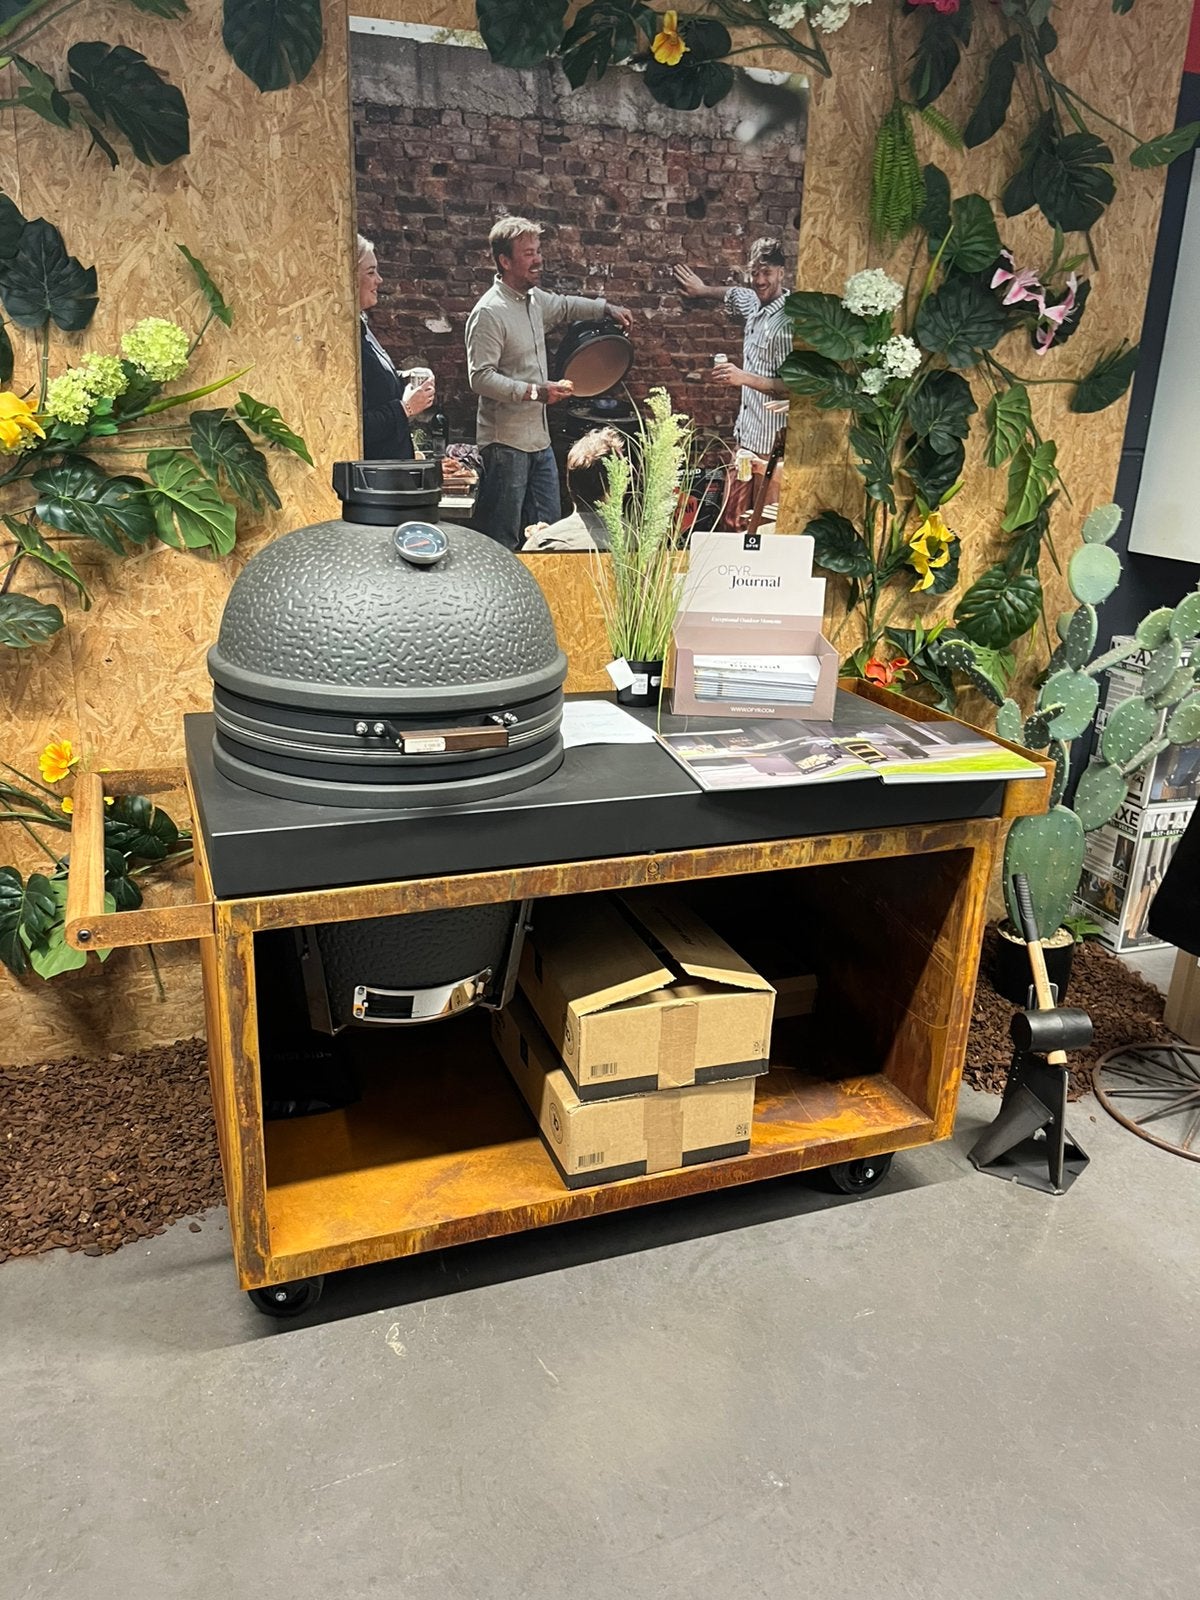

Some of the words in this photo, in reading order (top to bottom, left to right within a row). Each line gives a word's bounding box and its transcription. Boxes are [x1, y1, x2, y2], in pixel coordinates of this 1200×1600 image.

[718, 564, 752, 576] OFYR
[729, 575, 781, 590] Journal
[730, 705, 775, 714] WWW.OFYR.COM
[1115, 805, 1140, 828] XE
